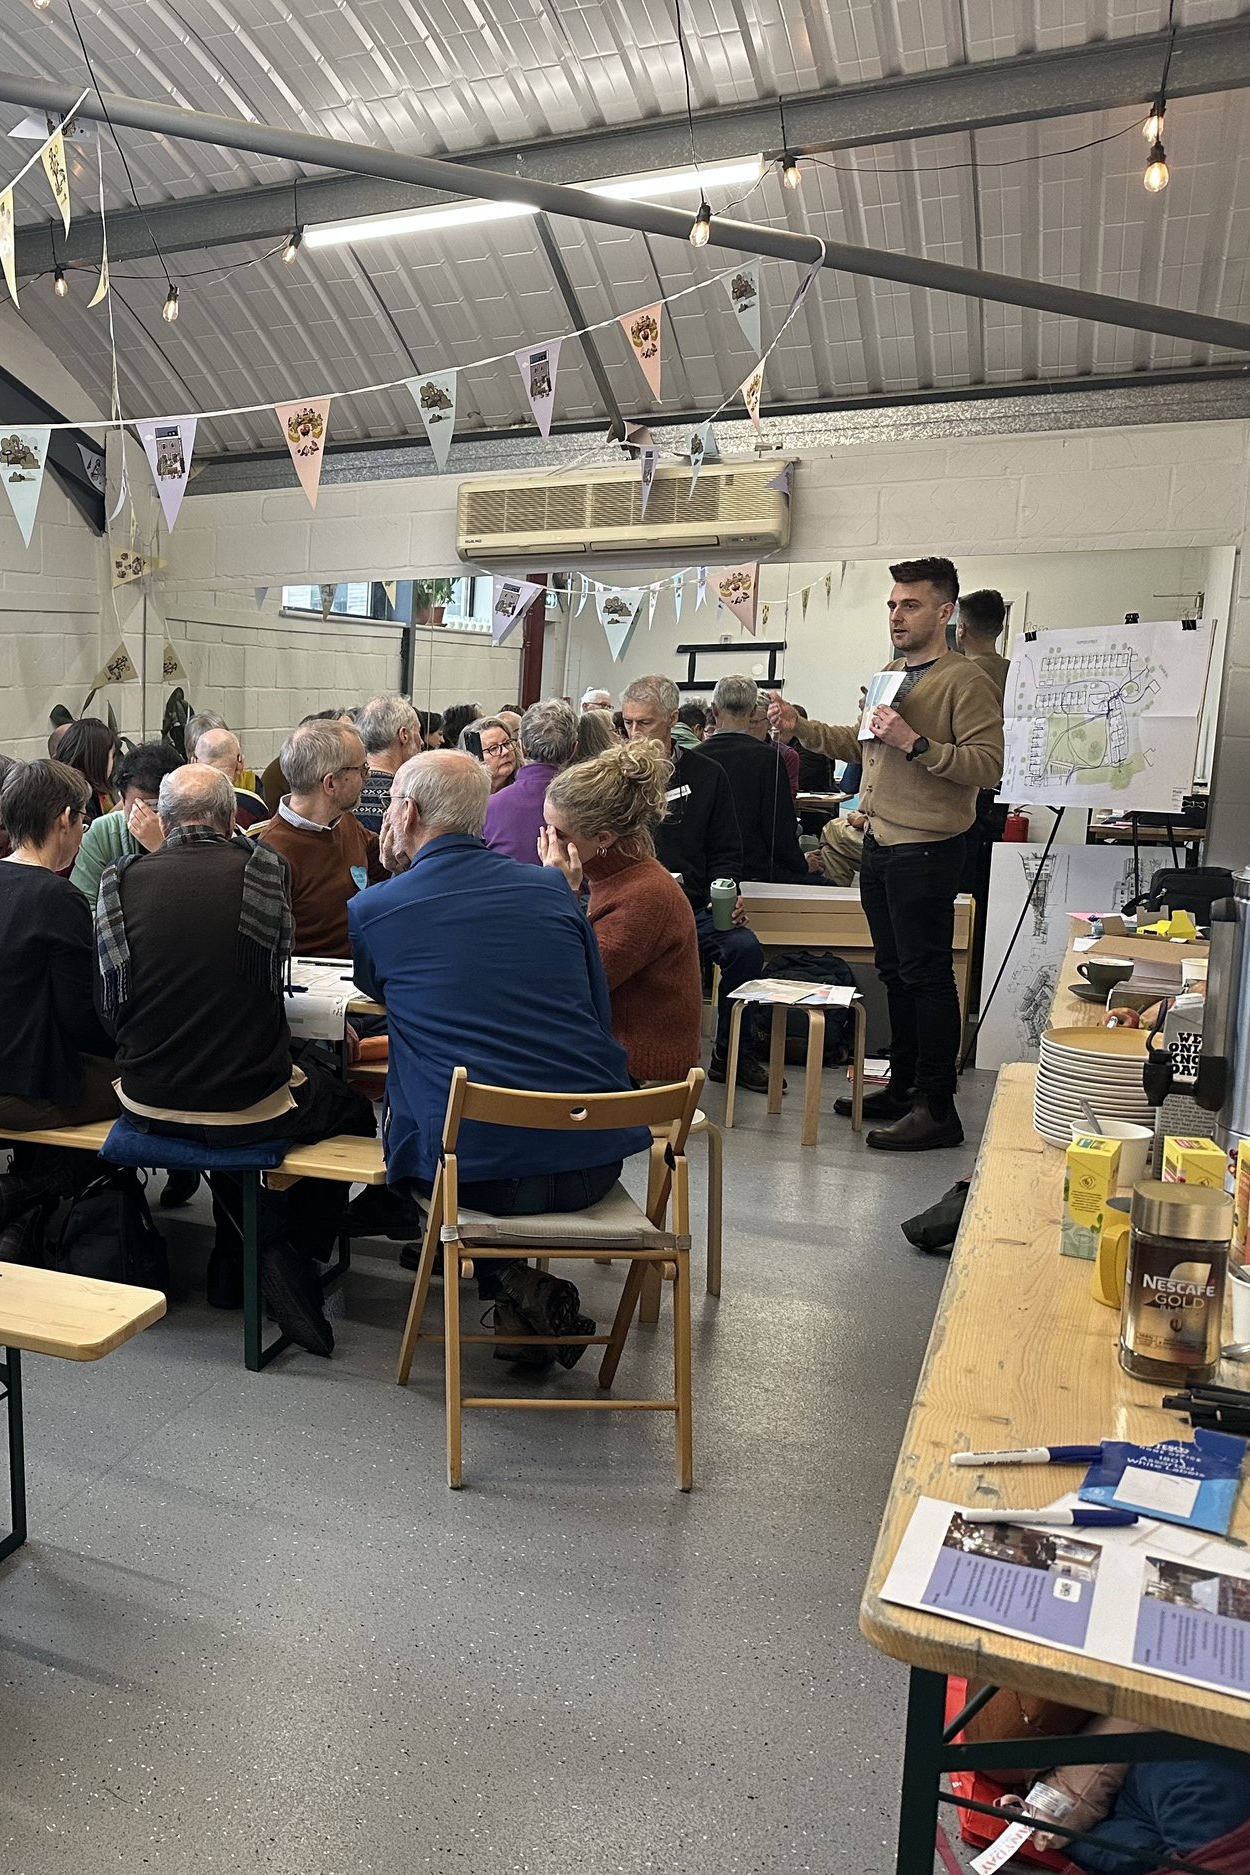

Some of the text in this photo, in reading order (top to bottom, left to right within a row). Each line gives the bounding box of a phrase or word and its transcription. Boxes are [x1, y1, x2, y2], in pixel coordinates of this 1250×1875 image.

[1178, 1032, 1202, 1045] WE
[1171, 1053, 1199, 1065] KNO
[1155, 1293, 1205, 1309] GOLD
[1155, 1444, 1190, 1454] TESCO
[1127, 1457, 1206, 1478] White Labels
[1139, 1456, 1195, 1472] Assorted
